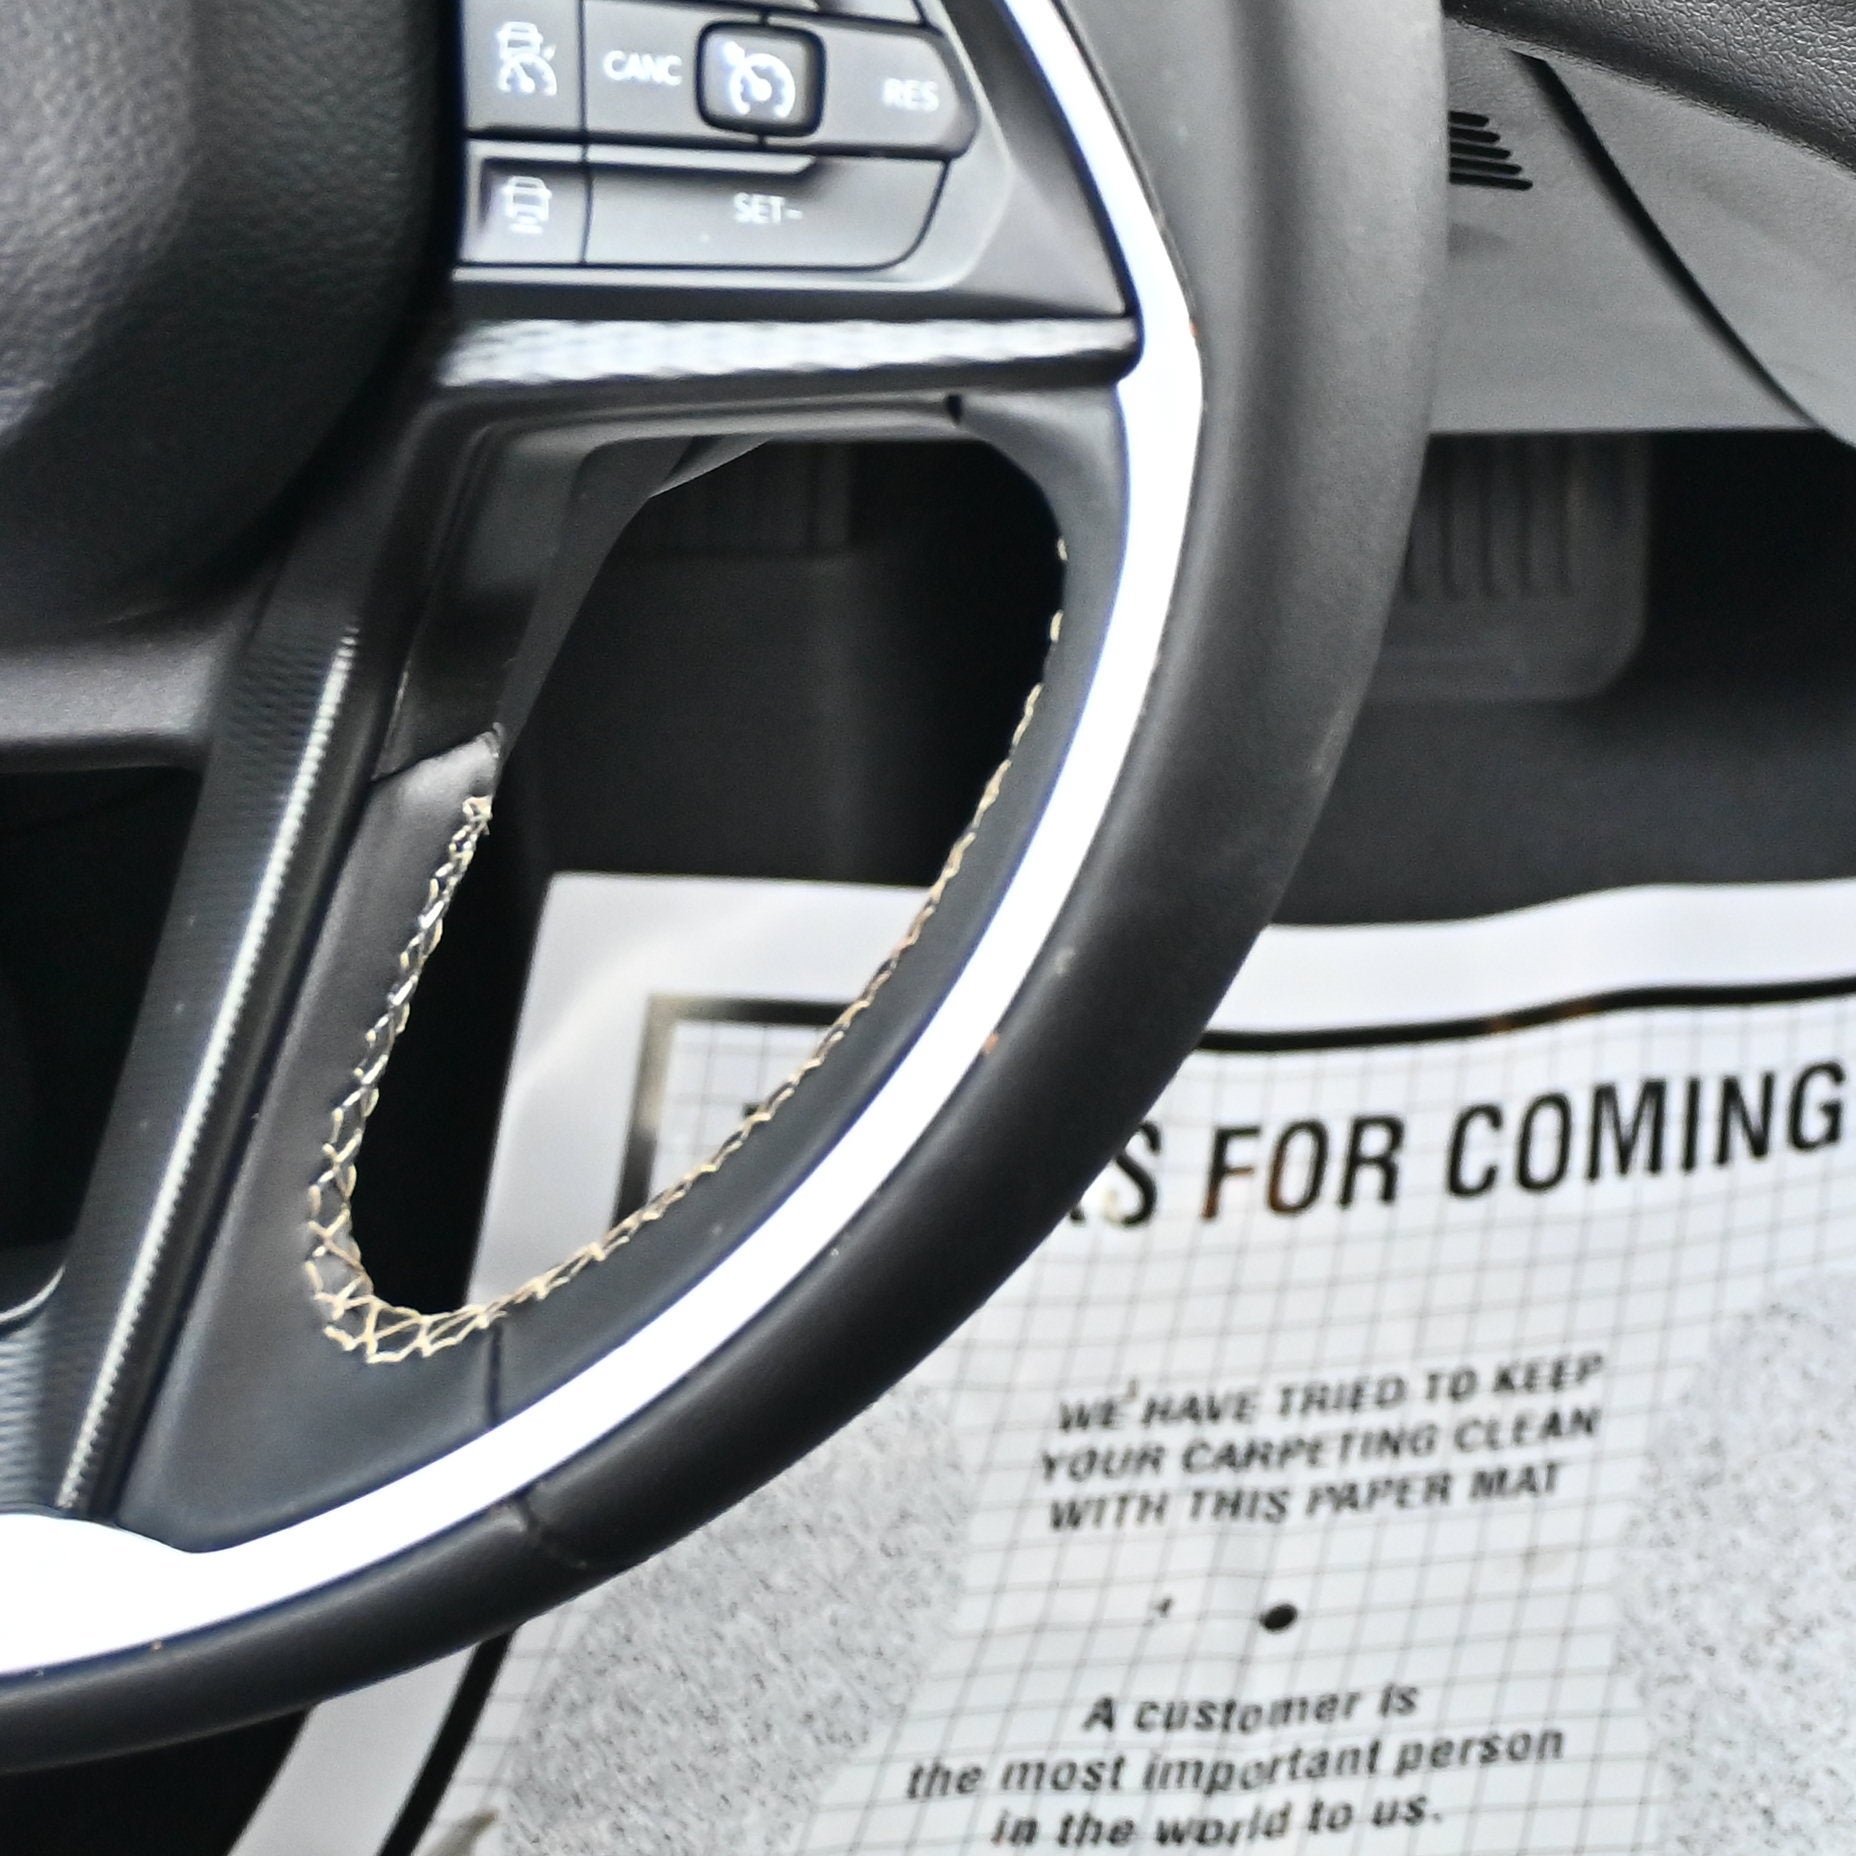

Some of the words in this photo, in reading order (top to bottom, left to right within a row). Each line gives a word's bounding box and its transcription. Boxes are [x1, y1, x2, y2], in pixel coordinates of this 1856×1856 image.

[602, 50, 683, 88] CANC
[882, 77, 939, 112] RES
[1203, 1115, 1405, 1219] FOR
[1447, 1060, 1846, 1197] COMING
[1058, 1399, 1118, 1433] WE
[1141, 1386, 1257, 1429] HAVE
[1278, 1375, 1407, 1418] TRIED
[1426, 1366, 1478, 1402] TO
[1494, 1352, 1605, 1394] KEEP
[1040, 1444, 1167, 1482] YOUR
[1182, 1421, 1439, 1475] CARPETING
[1454, 1406, 1601, 1452] CLEAN
[1049, 1492, 1170, 1530] WITH
[1191, 1485, 1288, 1524] THIS
[1306, 1471, 1450, 1516] PAPER
[1469, 1462, 1563, 1499] MAT
[1084, 1697, 1114, 1732] A
[1134, 1691, 1361, 1733] customer
[1379, 1681, 1417, 1716] is
[907, 1759, 984, 1800] the
[1002, 1755, 1125, 1792] most
[1143, 1741, 1381, 1797] important
[1400, 1727, 1564, 1773] person
[991, 1811, 1039, 1845] in
[1058, 1811, 1134, 1846] the
[1155, 1803, 1290, 1845] world
[1308, 1798, 1353, 1832] to
[1372, 1793, 1442, 1826] us.
